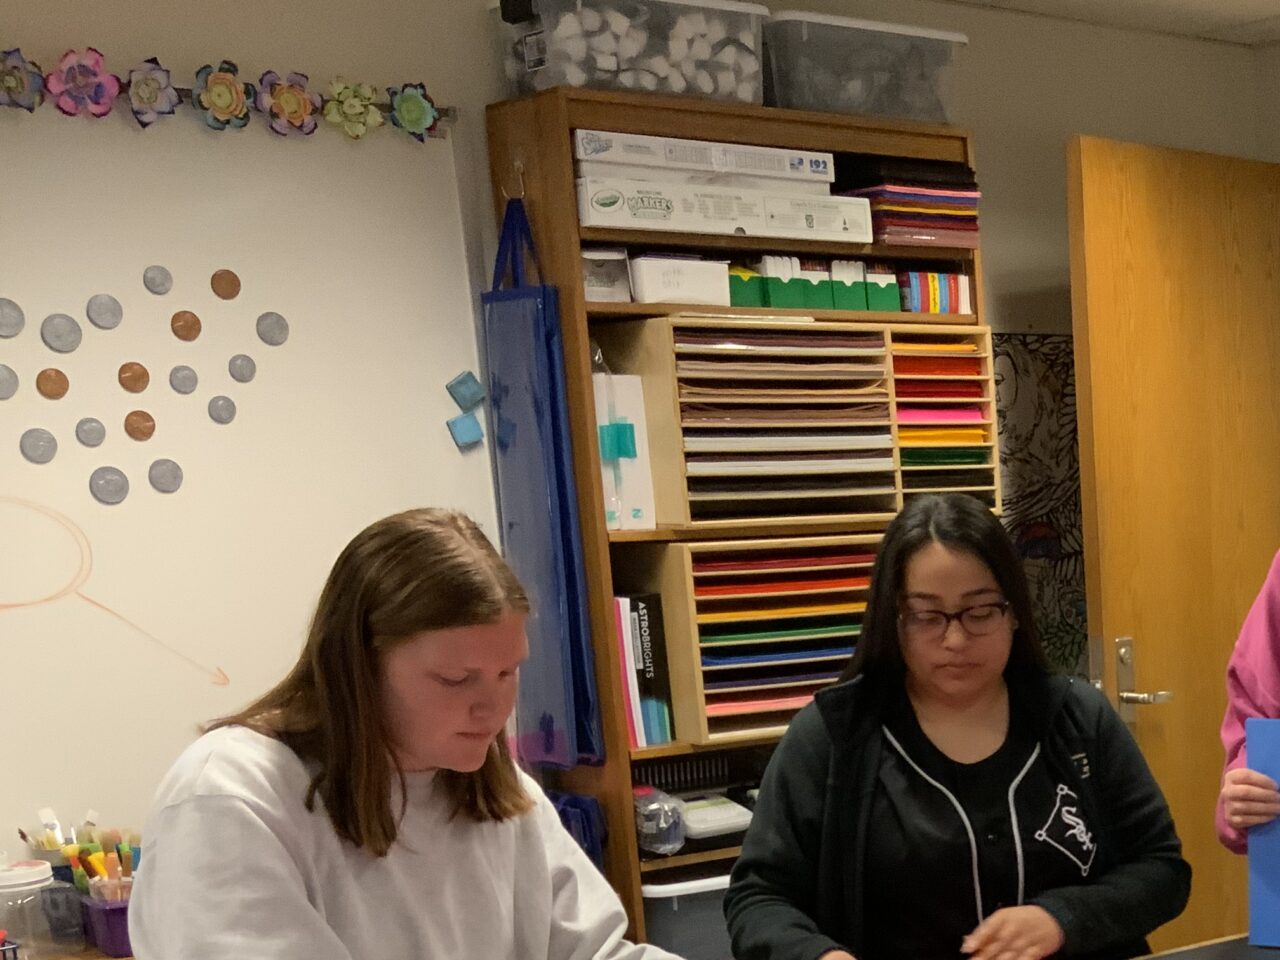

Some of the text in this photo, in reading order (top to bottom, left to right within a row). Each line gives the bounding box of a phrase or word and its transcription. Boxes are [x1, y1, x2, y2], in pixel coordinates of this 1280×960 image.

[809, 159, 828, 170] 192
[638, 602, 654, 678] ASTROBRIGHTS
[1061, 806, 1094, 851] Sox
